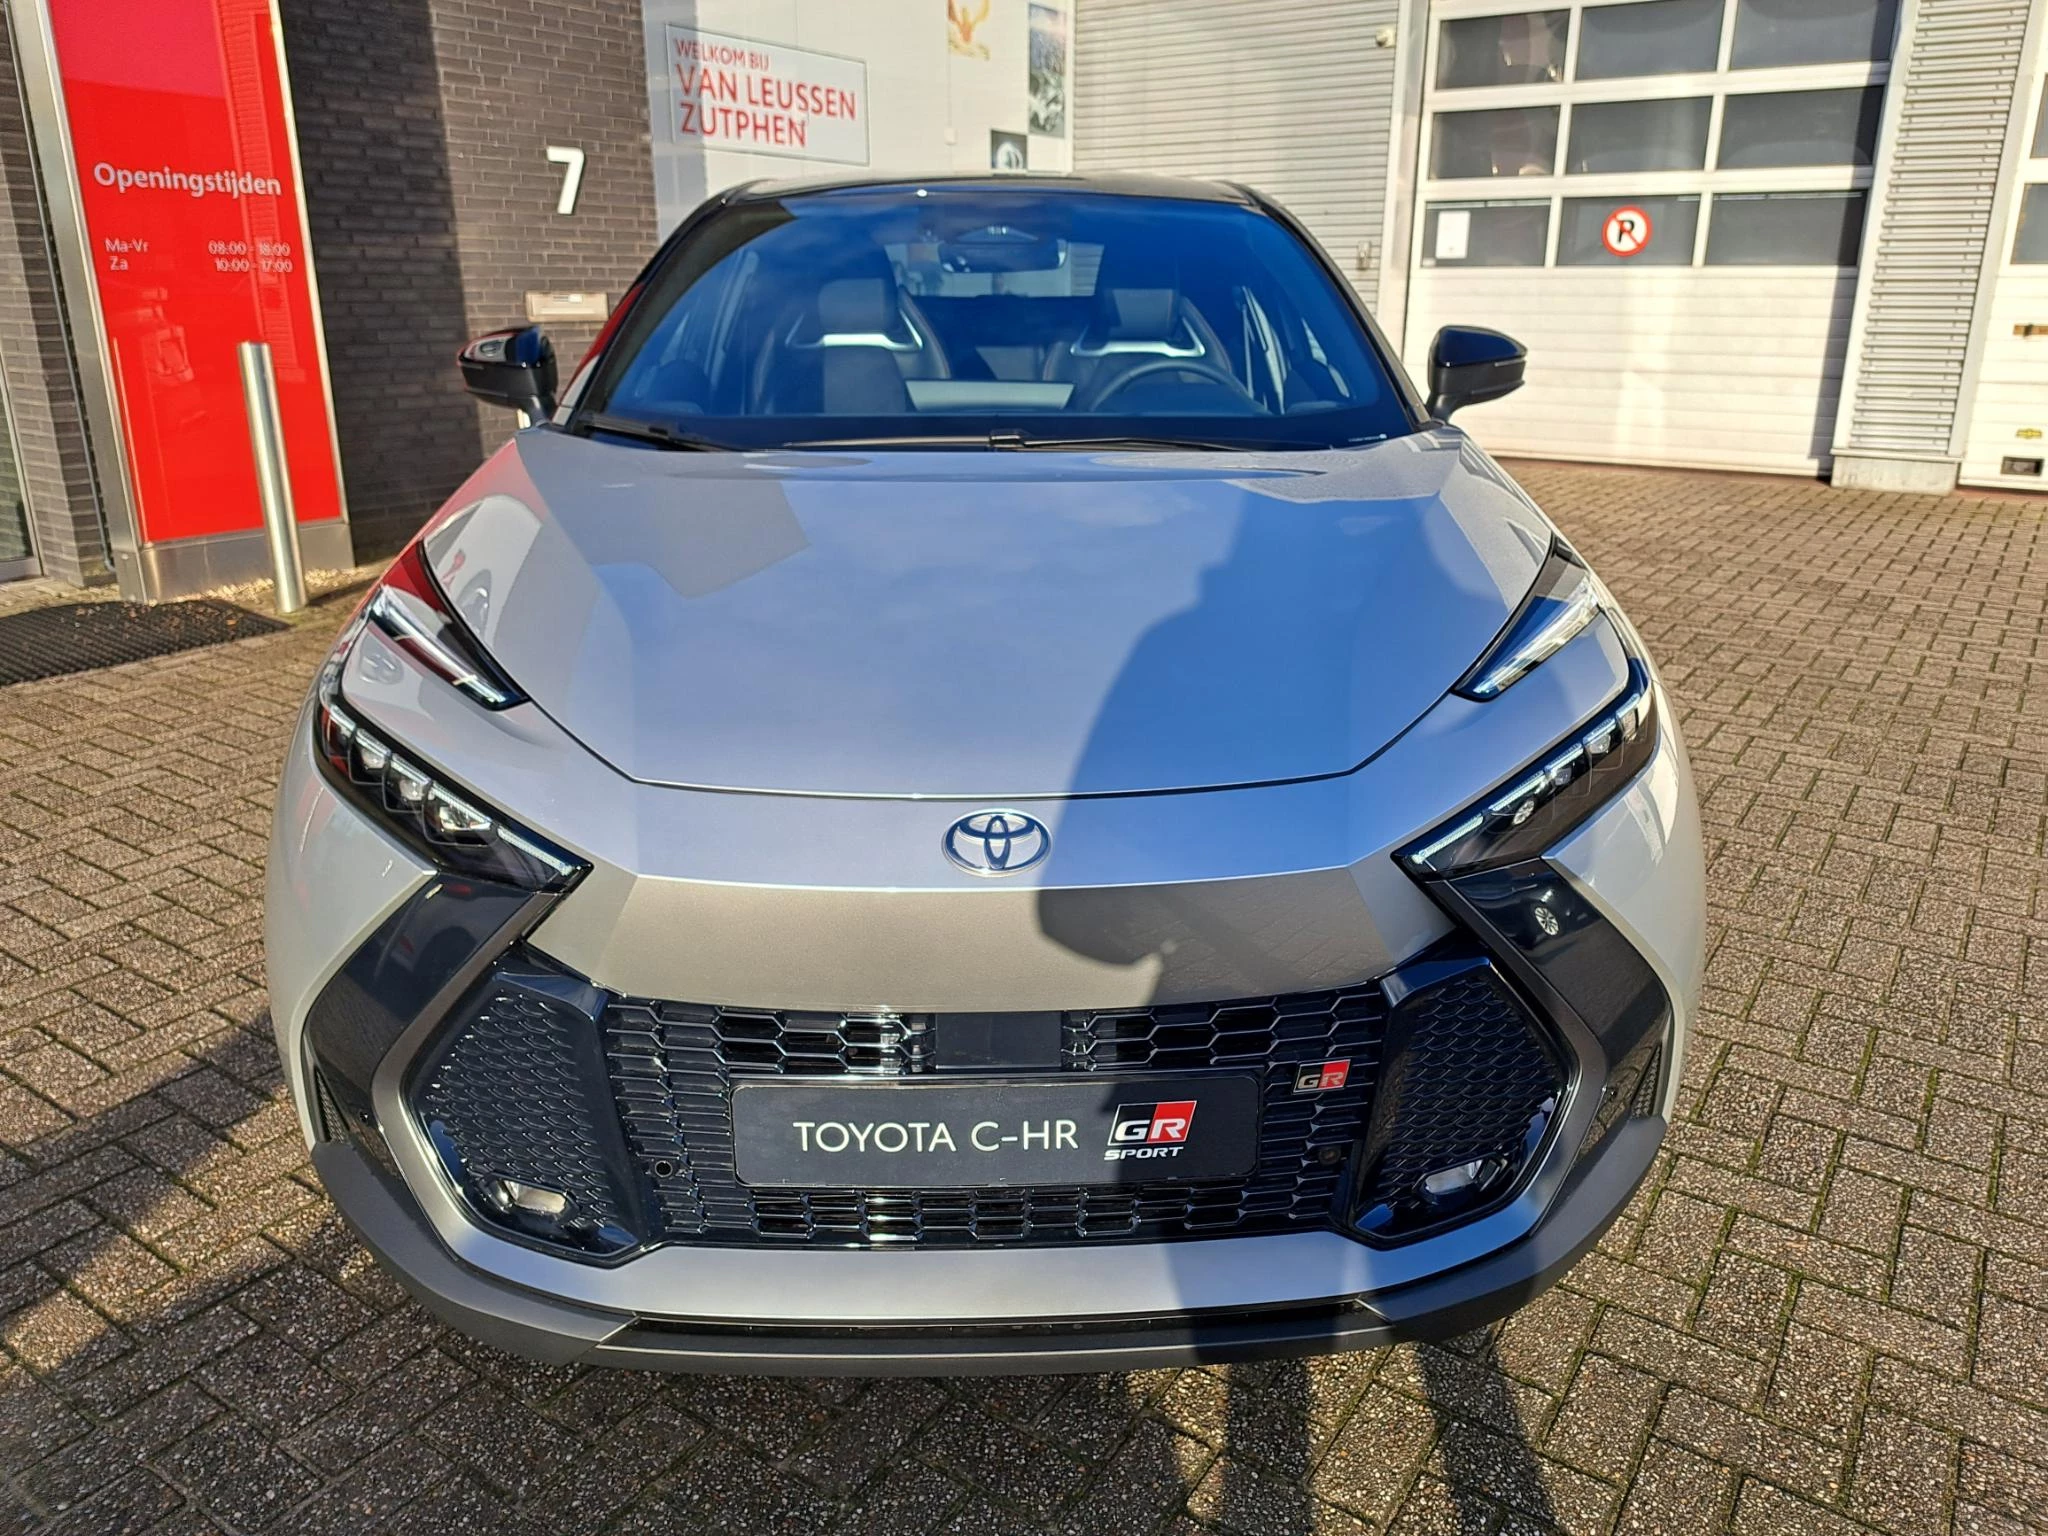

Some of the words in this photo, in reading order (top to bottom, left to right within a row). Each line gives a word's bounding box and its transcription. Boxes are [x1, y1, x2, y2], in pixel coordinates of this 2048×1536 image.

[674, 38, 745, 67] WELKOM
[748, 52, 770, 72] BIJ
[675, 63, 739, 104] VAN
[746, 74, 857, 120] LEUSSEN
[680, 102, 807, 147] ZUTPHEN
[94, 161, 282, 199] Openingstijden
[546, 146, 585, 215] 7
[105, 237, 149, 253] Ma-Vr
[208, 239, 248, 255] 08:00
[109, 255, 129, 271] Za
[215, 257, 250, 272] 10:00
[261, 258, 293, 273] 17:00
[1297, 1071, 1344, 1090] GR
[792, 1121, 957, 1153] TOYOTA
[970, 1119, 1079, 1152] C-HR
[1114, 1117, 1186, 1142] GR
[1103, 1146, 1184, 1161] SPORT
